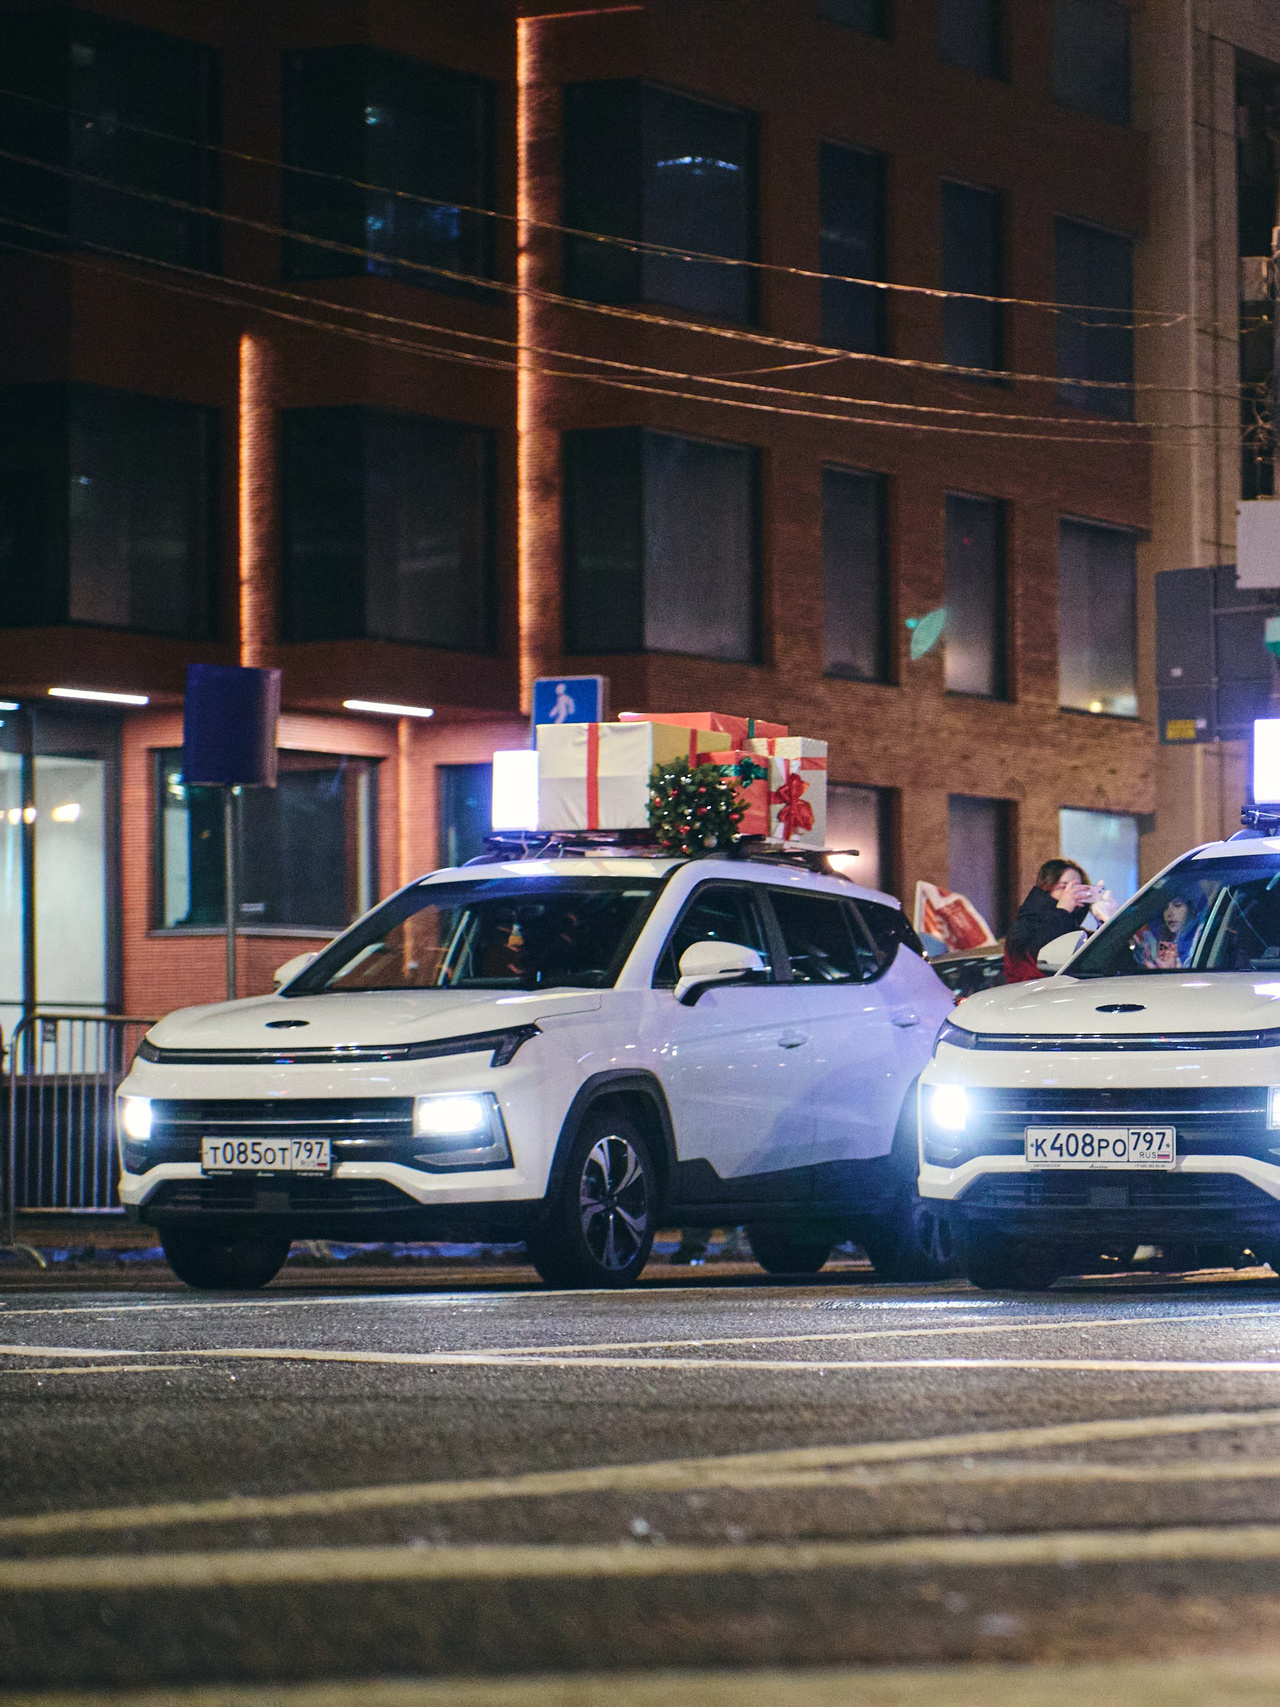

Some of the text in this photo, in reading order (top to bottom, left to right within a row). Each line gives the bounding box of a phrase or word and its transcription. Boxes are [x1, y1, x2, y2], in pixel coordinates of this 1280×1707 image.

[292, 1140, 325, 1159] 797
[1130, 1131, 1167, 1151] 797
[1139, 1151, 1157, 1159] RUS
